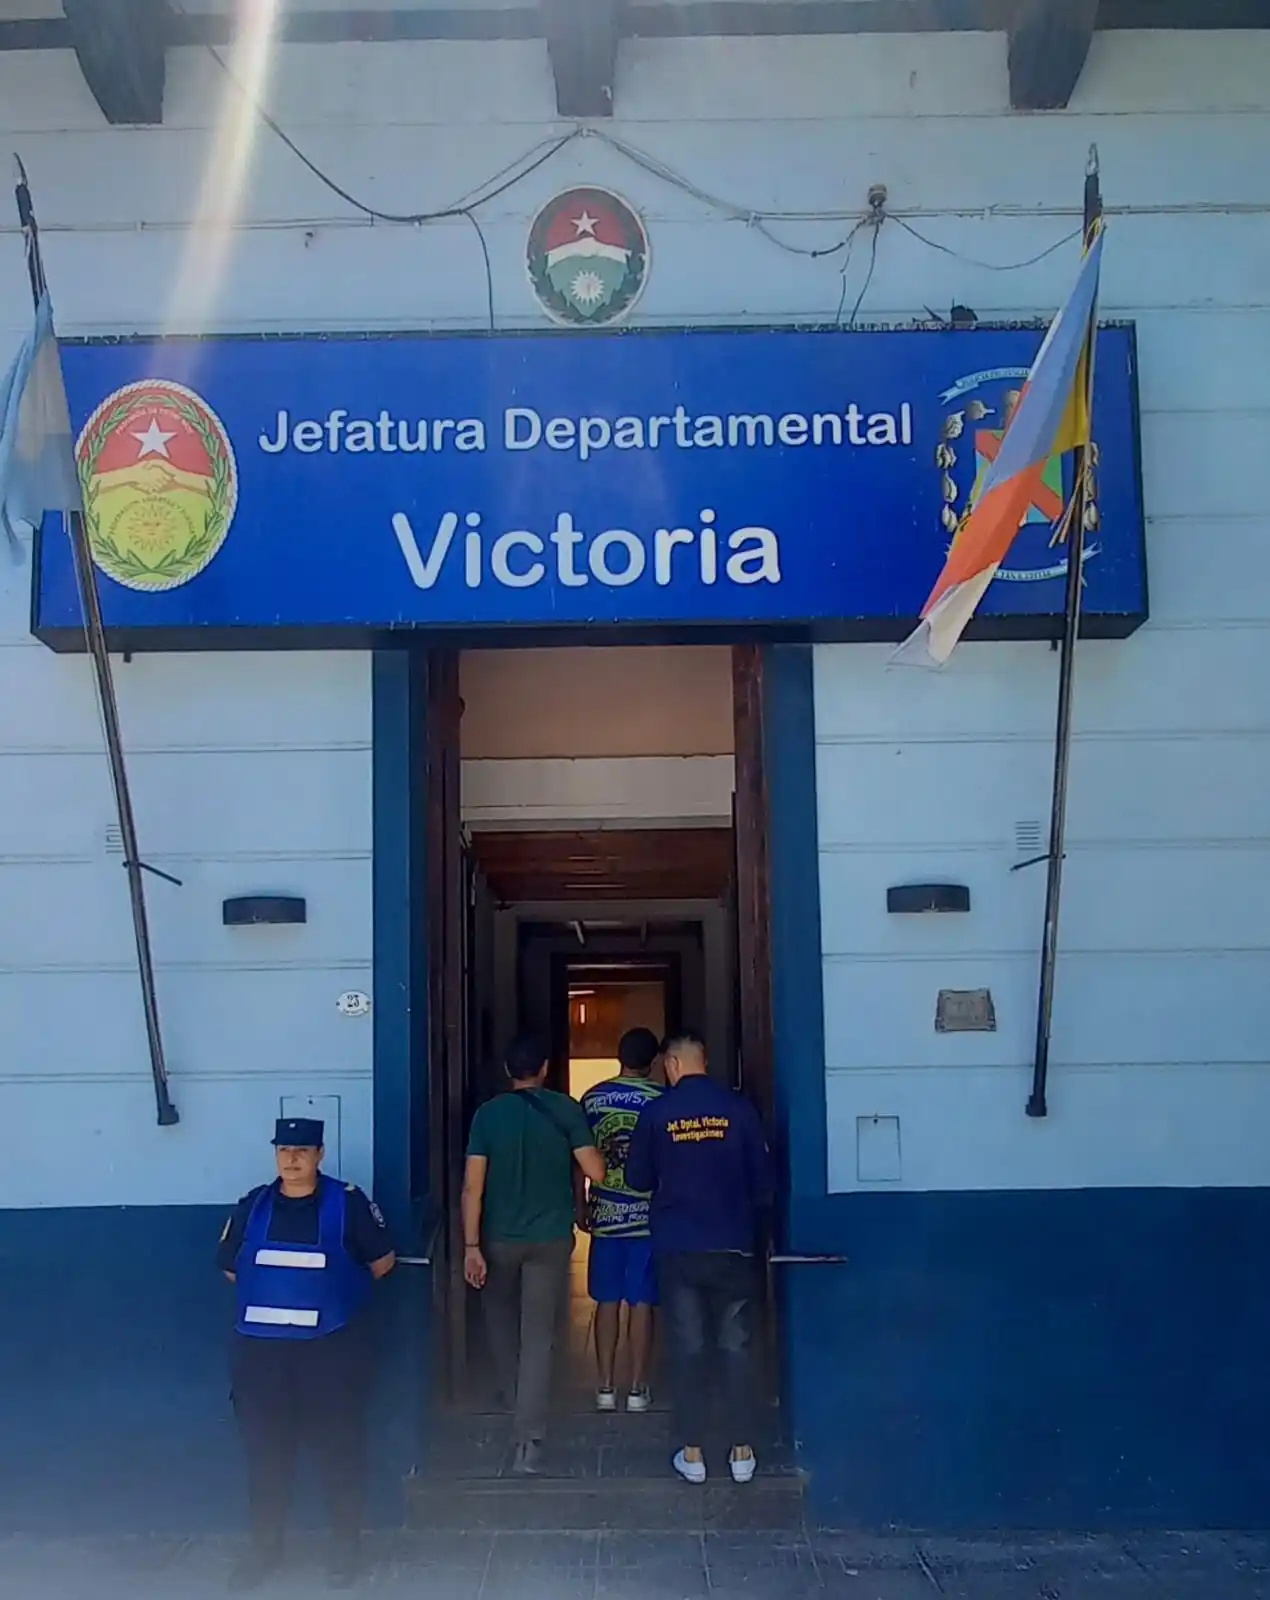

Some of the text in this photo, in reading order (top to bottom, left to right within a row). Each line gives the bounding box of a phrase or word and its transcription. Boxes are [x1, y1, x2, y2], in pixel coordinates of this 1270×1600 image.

[258, 402, 912, 461] Jefatura Departamental
[391, 508, 782, 589] Victoria
[346, 994, 360, 1008] 23
[702, 1115, 729, 1127] Victoria
[672, 1128, 724, 1142] Investigaciones
